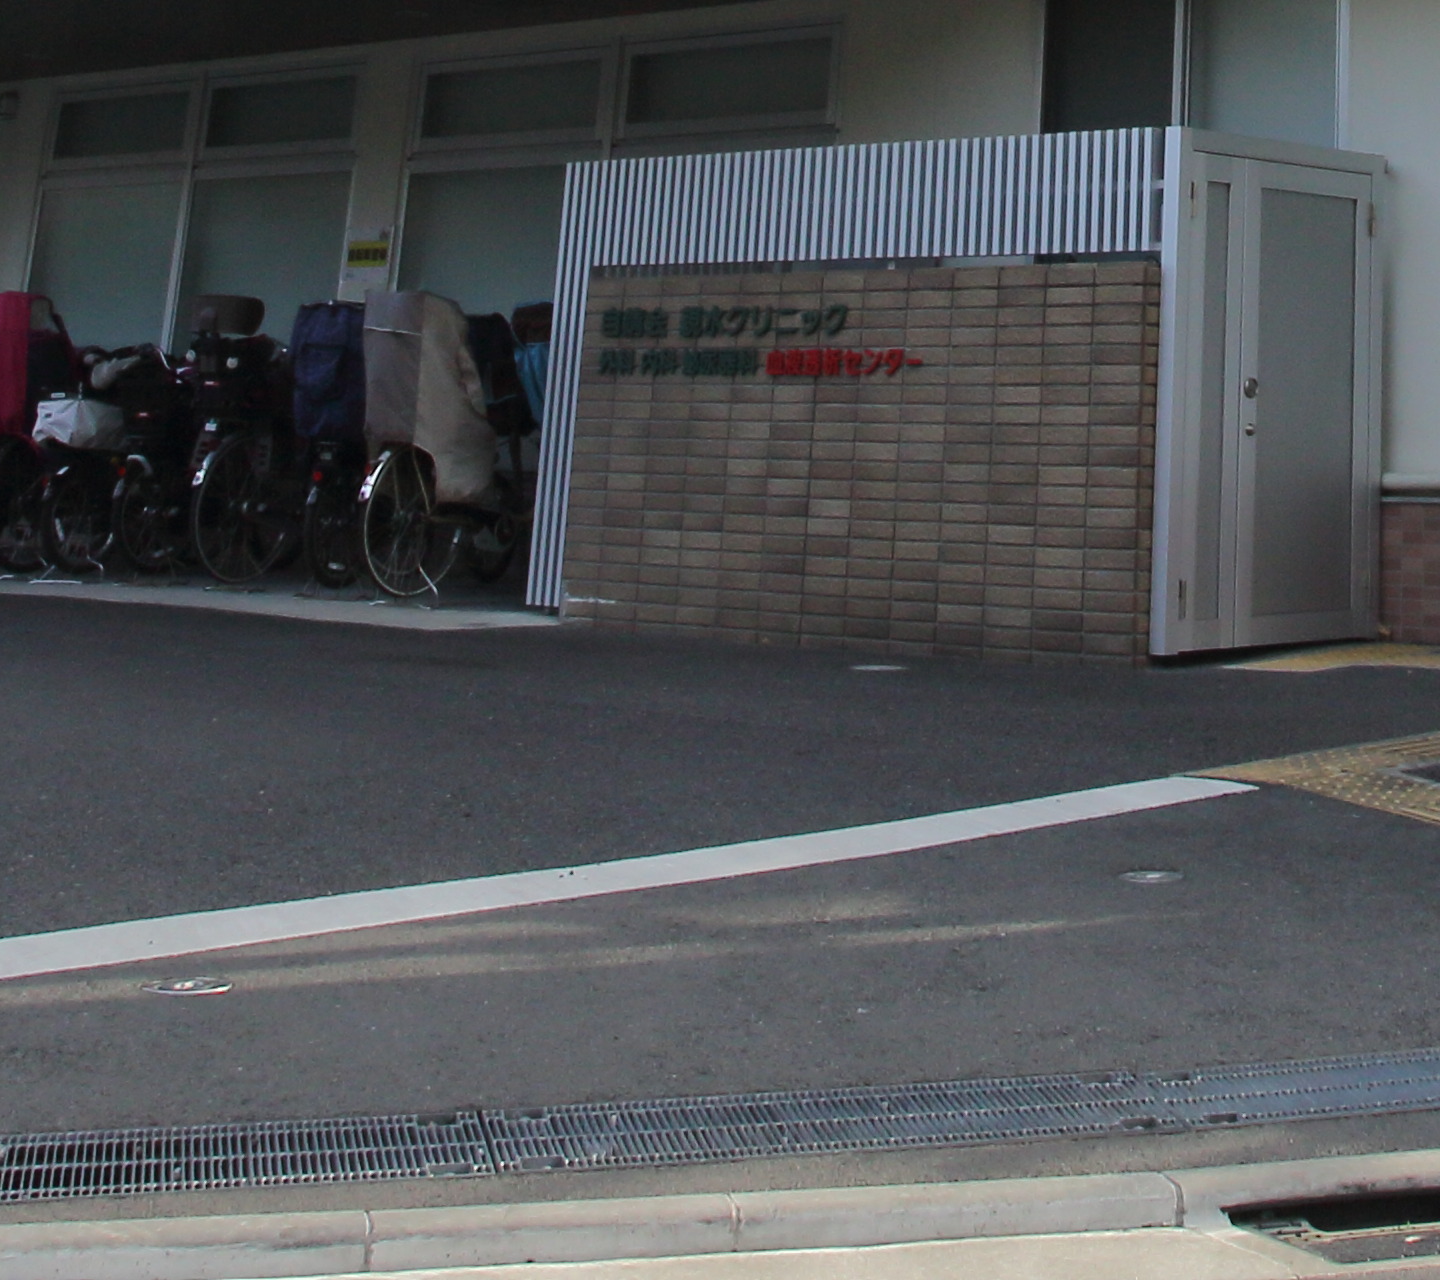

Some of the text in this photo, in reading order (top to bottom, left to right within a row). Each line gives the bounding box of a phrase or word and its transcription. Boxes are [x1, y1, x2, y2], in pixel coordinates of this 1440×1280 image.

[679, 304, 849, 338] 親水クリニック
